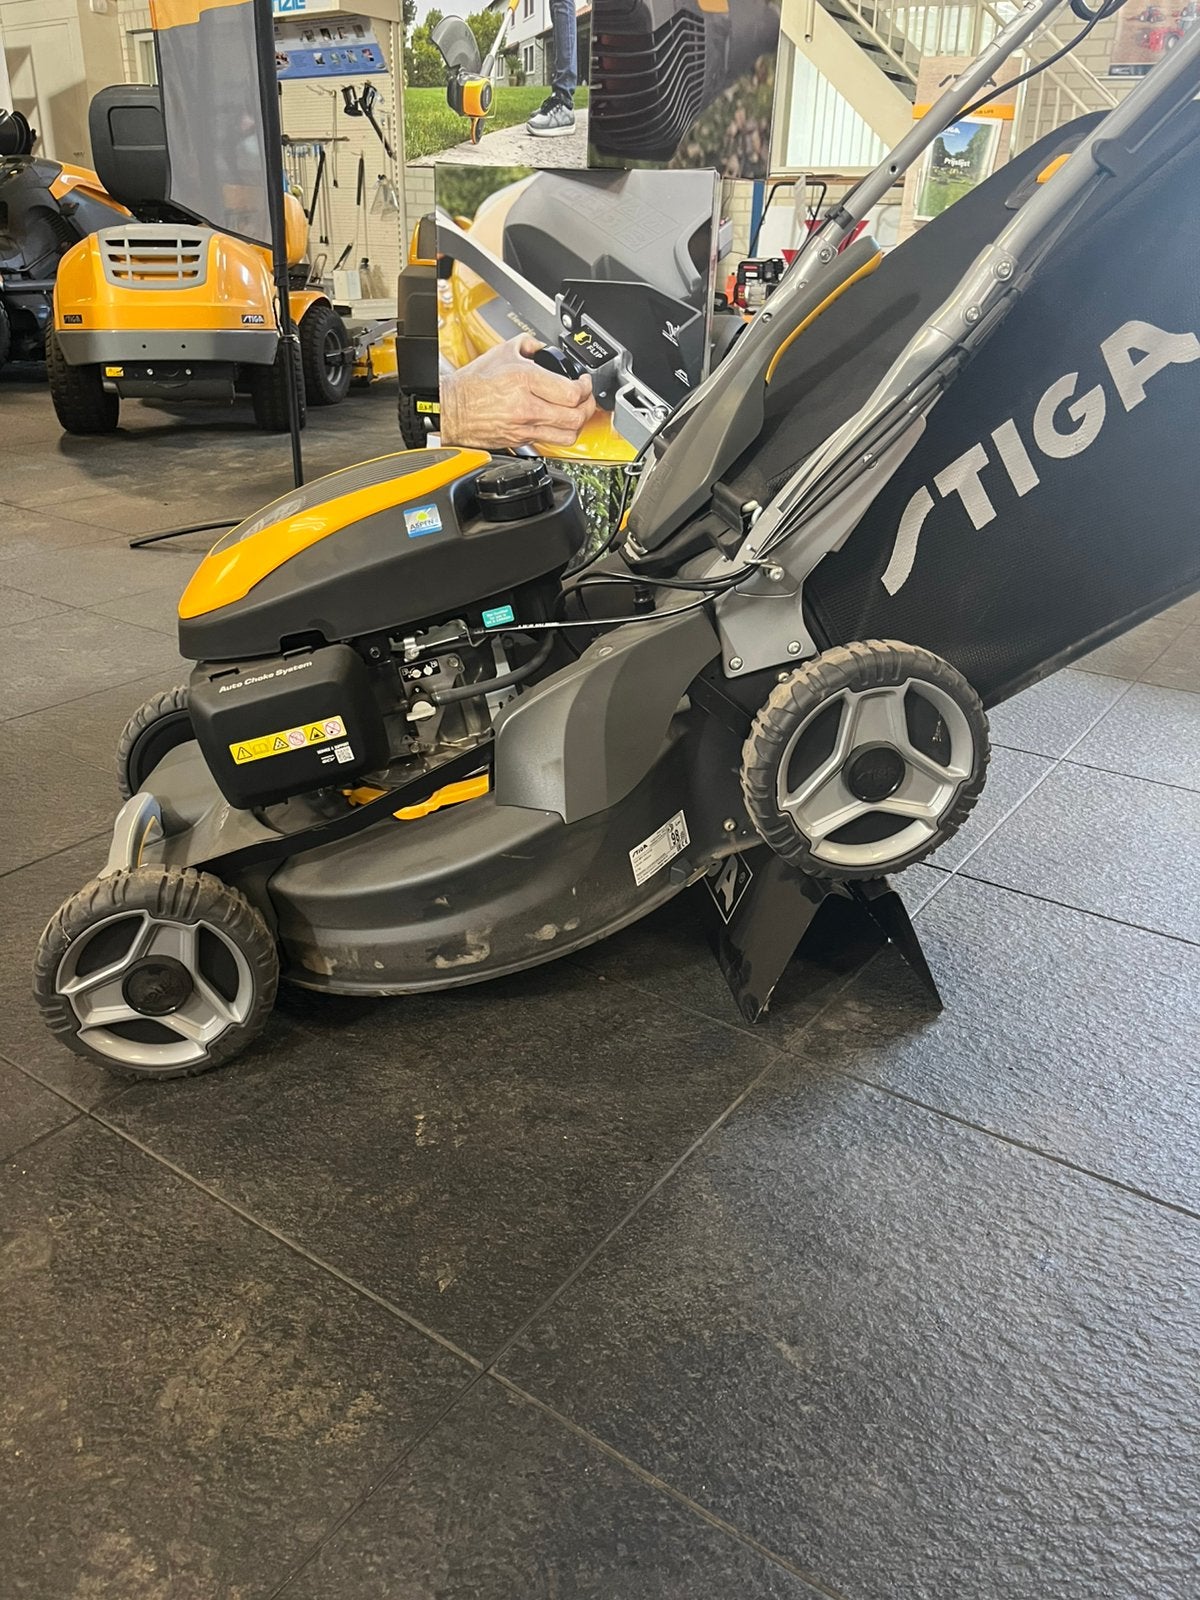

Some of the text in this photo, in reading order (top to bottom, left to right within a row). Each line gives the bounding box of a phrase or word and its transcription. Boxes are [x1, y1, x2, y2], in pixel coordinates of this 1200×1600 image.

[242, 315, 264, 323] STIGA
[586, 344, 603, 359] FLIP
[880, 320, 1200, 597] STIGA
[218, 661, 313, 694] Auto Choke System
